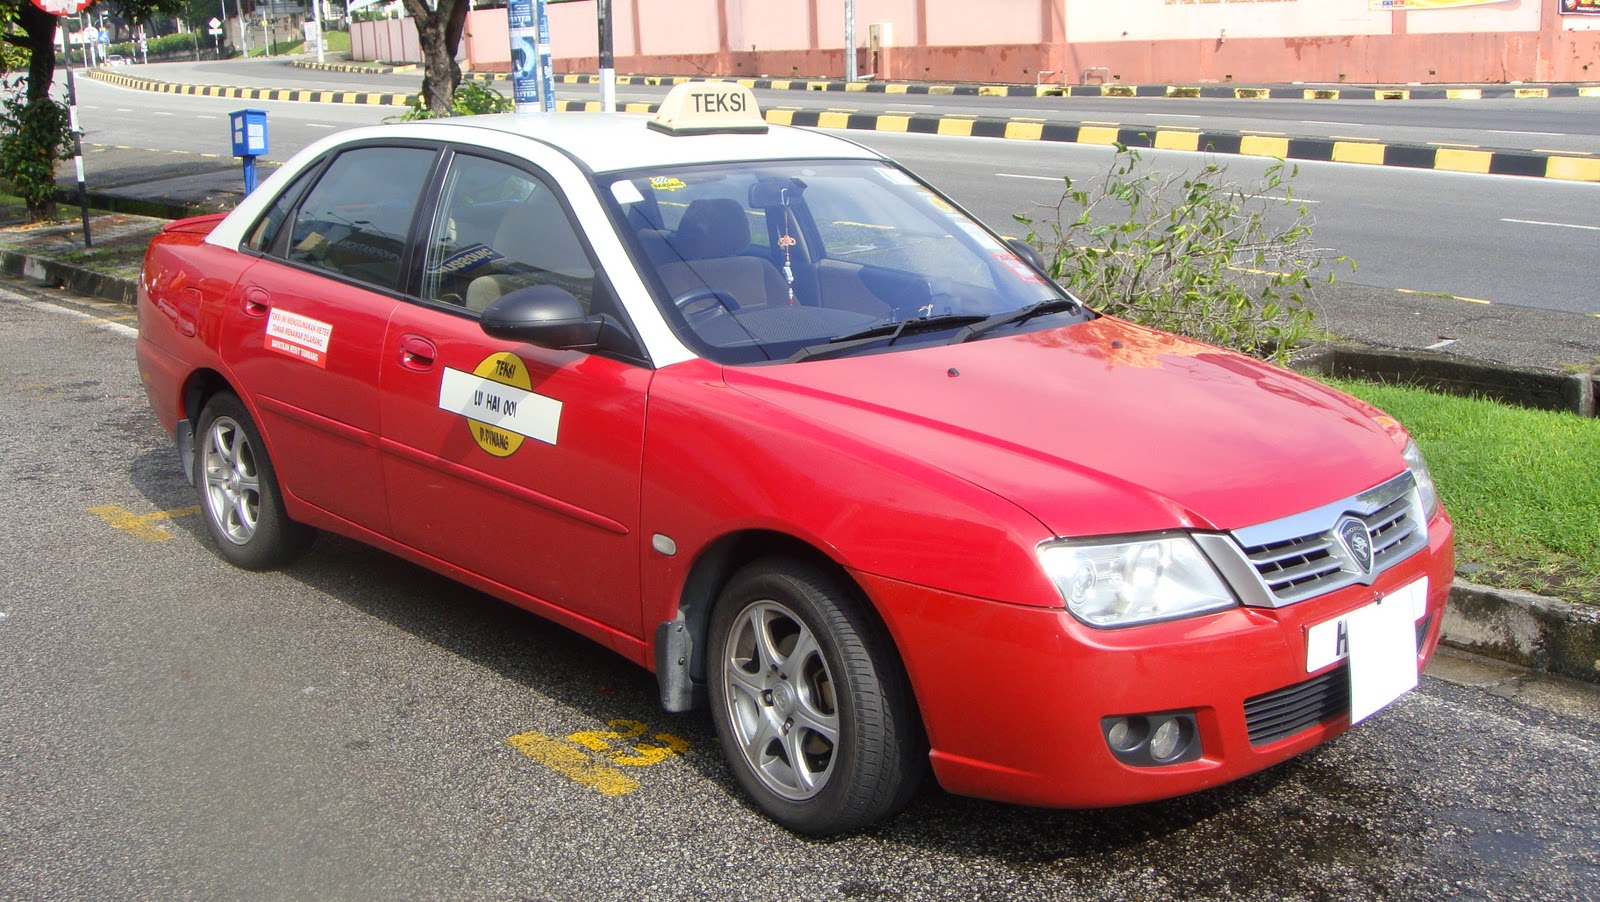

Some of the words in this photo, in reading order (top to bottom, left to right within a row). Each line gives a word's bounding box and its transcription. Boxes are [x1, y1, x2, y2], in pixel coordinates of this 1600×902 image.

[691, 93, 746, 112] TEKSI
[316, 326, 330, 336] METER
[496, 360, 516, 379] TEKSI
[474, 389, 483, 407] LU
[486, 393, 500, 413] HAI
[480, 427, 509, 451] P.PINANG
